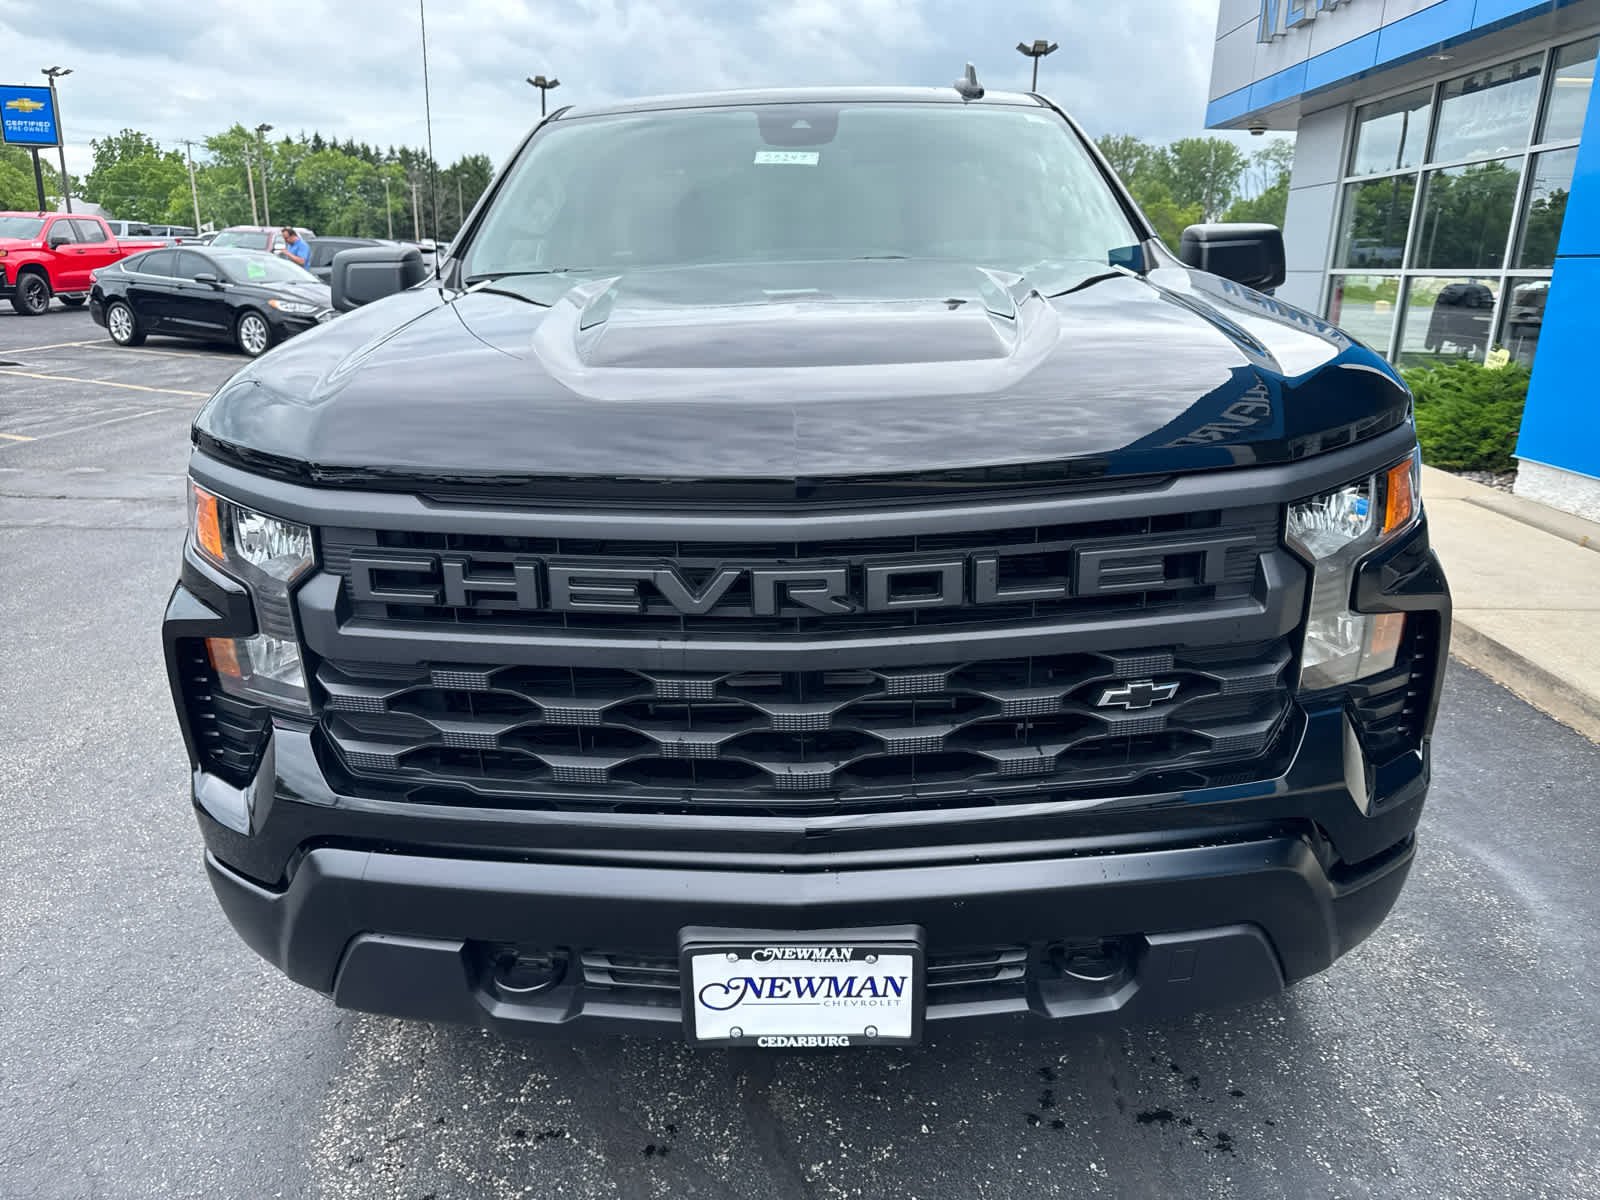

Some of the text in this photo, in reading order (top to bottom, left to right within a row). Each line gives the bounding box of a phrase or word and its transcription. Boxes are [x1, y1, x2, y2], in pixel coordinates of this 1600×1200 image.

[350, 537, 1257, 616] CHEVROLET
[752, 948, 853, 962] NEWMAN
[699, 976, 908, 1010] NEWMAN
[823, 1000, 902, 1008] CHEVROLET
[757, 1036, 850, 1047] CEDARBURG
